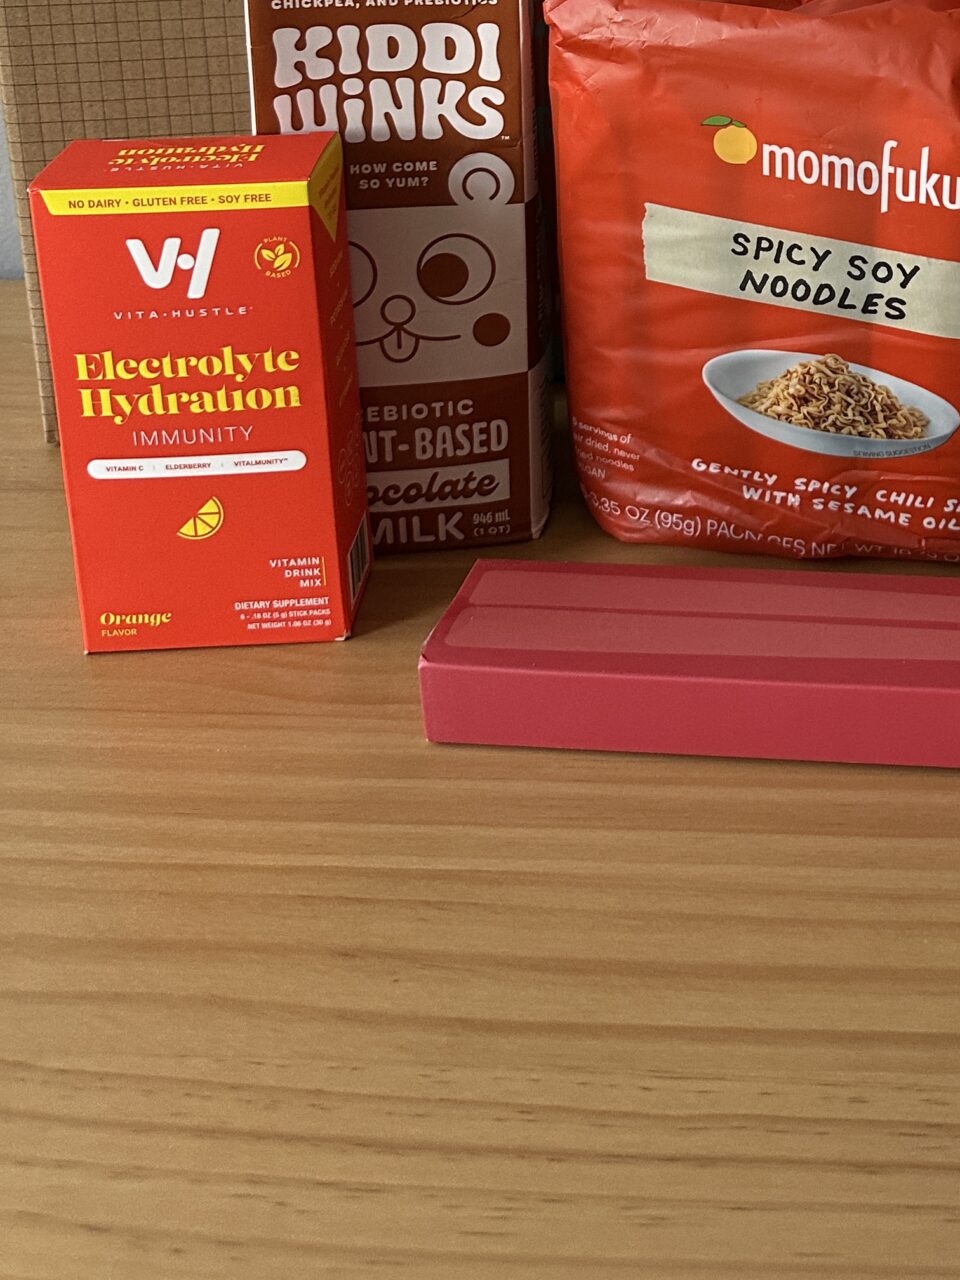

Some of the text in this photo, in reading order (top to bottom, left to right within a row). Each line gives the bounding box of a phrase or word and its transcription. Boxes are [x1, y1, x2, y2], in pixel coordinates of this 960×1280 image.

[272, 23, 501, 88] KIDDI
[118, 144, 264, 156] Hydration
[108, 154, 259, 165] Electrolyte
[350, 161, 438, 174] HOW COME
[359, 176, 429, 190] SO YUM?
[68, 193, 272, 209] NO DAIRY GLUTEN FREE SOY FREE
[263, 236, 288, 244] PLANT
[731, 233, 920, 289] SPICY SOY
[265, 269, 292, 279] BASED
[739, 270, 906, 320] NOODLES
[74, 345, 299, 382] Electrolyte
[80, 384, 302, 425] Hydration
[362, 399, 474, 422] EBIOTIC
[133, 425, 253, 446] IMMUNITY
[578, 421, 632, 444] servings of
[363, 419, 508, 463] NT-BASED
[614, 448, 640, 461] never
[106, 464, 137, 472] VITAMIN
[138, 464, 144, 472] C
[165, 462, 212, 471] ELDERBERRY
[595, 455, 634, 472] noodles
[368, 471, 499, 506] ocolate
[692, 458, 777, 486] GENTLY
[794, 477, 858, 498] SPICY
[875, 489, 934, 509] CHILI
[742, 485, 960, 531] WITH SESAME OIL
[473, 509, 510, 524] 946 mL
[625, 505, 651, 526] OZ
[655, 510, 701, 537] (95g)
[373, 512, 464, 545] MILK
[474, 524, 510, 536] (1 QT)
[269, 557, 320, 568] VITAMIN
[284, 568, 321, 578] DRINK
[300, 578, 321, 588] MIX
[235, 597, 329, 610] DIETARY SUPPLEMENT
[288, 609, 308, 617] STICK
[309, 608, 331, 616] PACKS
[100, 612, 172, 629] Orange
[248, 622, 260, 630] NET
[261, 621, 286, 629] WEIGHT
[102, 628, 137, 637] FLAVOR
